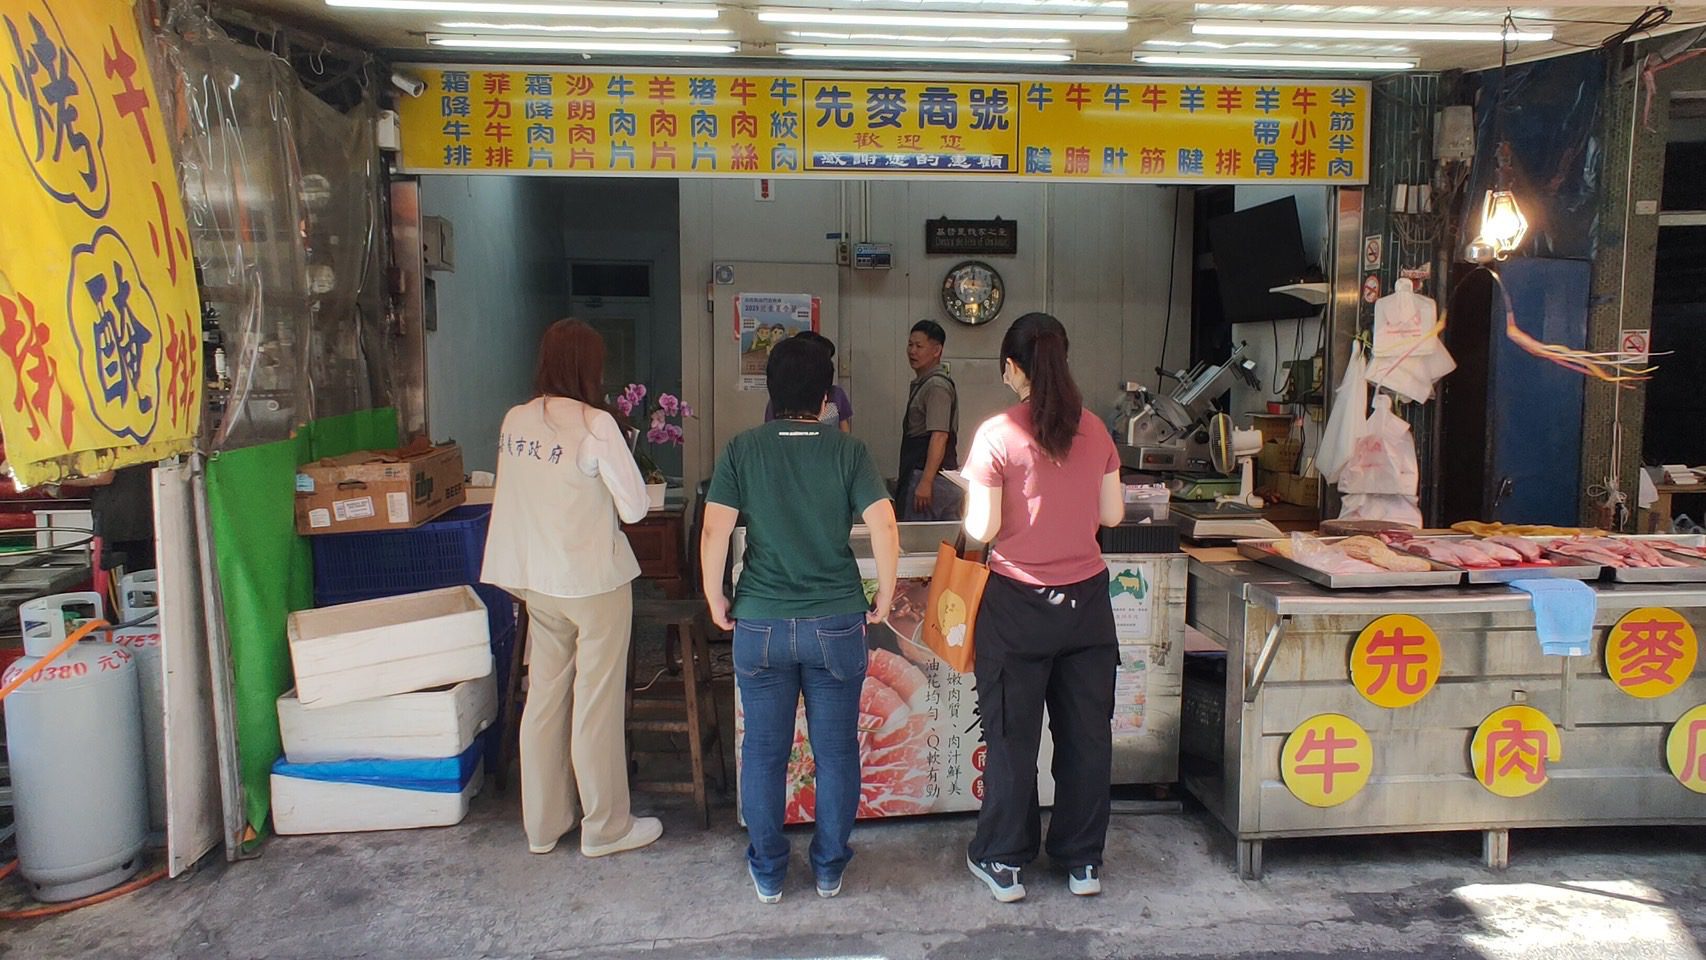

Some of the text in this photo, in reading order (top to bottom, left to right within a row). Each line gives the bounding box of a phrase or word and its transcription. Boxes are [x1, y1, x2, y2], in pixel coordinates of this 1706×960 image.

[2, 12, 98, 193] 烤
[441, 71, 472, 166] 霜降牛排
[483, 72, 513, 167] 菲力牛排
[524, 73, 555, 168] 霜降肉片
[566, 74, 596, 169] 沙朗肉片
[607, 75, 637, 169] 牛肉片
[648, 76, 677, 170] 羊肉片
[730, 78, 759, 171] 牛肉絲
[770, 77, 799, 171] 牛絞肉
[814, 85, 1009, 131] 先麥商號
[1216, 86, 1242, 176] 羊排
[1253, 86, 1280, 176] 羊帶骨
[1290, 87, 1317, 176] 牛小排
[1328, 87, 1355, 177] 半筋半肉
[103, 23, 197, 434] 牛小排
[445, 483, 462, 499] BEEF
[1366, 618, 1685, 695] 先 麥
[1294, 719, 1549, 794] 牛 肉
